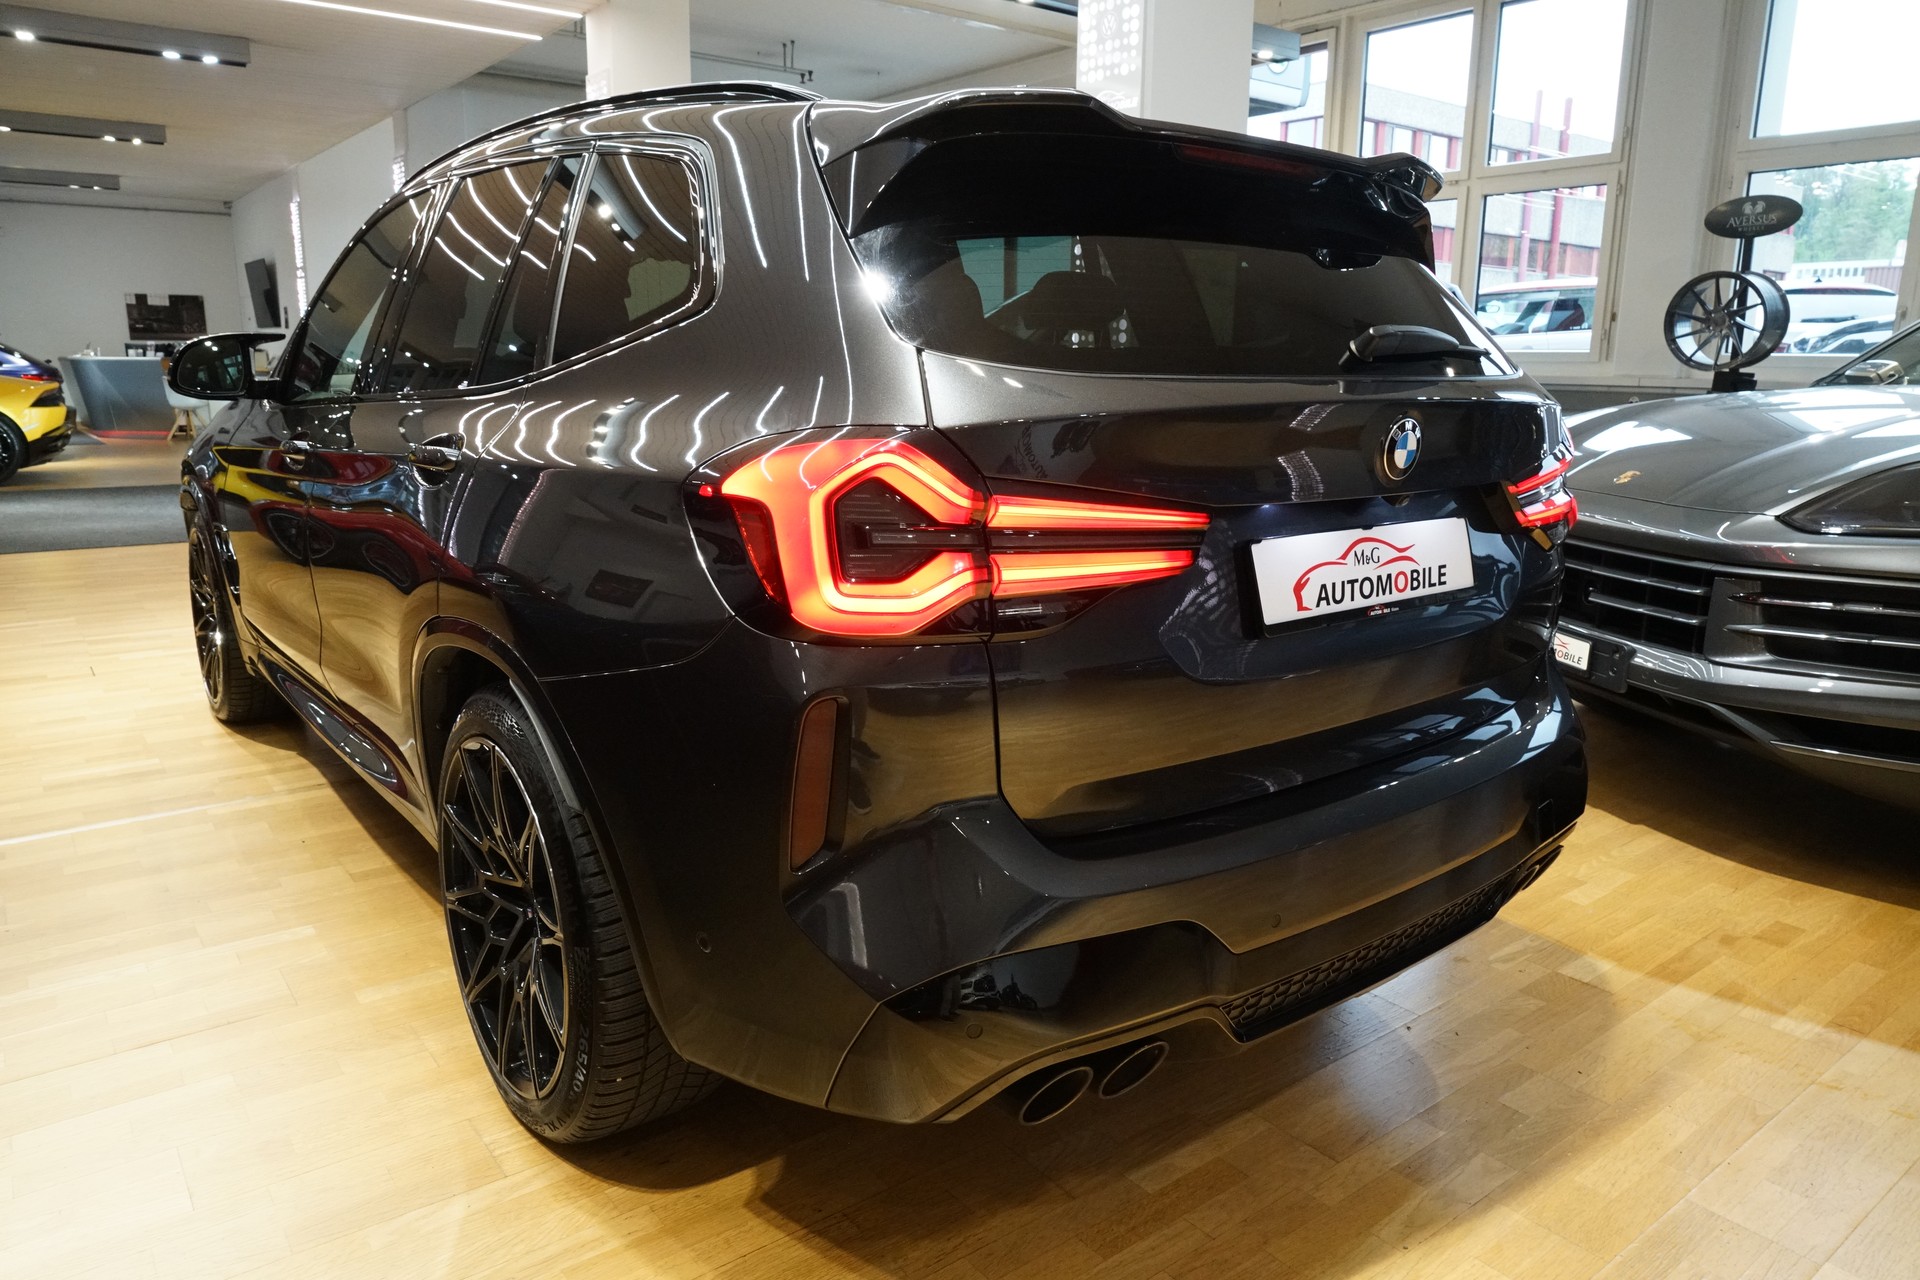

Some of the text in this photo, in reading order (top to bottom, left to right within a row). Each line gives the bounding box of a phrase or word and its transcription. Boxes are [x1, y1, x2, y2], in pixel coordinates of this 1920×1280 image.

[1726, 213, 1777, 228] AVERSUS
[1391, 420, 1421, 441] BMW
[1354, 547, 1380, 567] M&G
[1315, 564, 1447, 608] AUTOMOBILE
[1554, 648, 1583, 665] OBILE
[572, 1023, 590, 1094] 265/40
